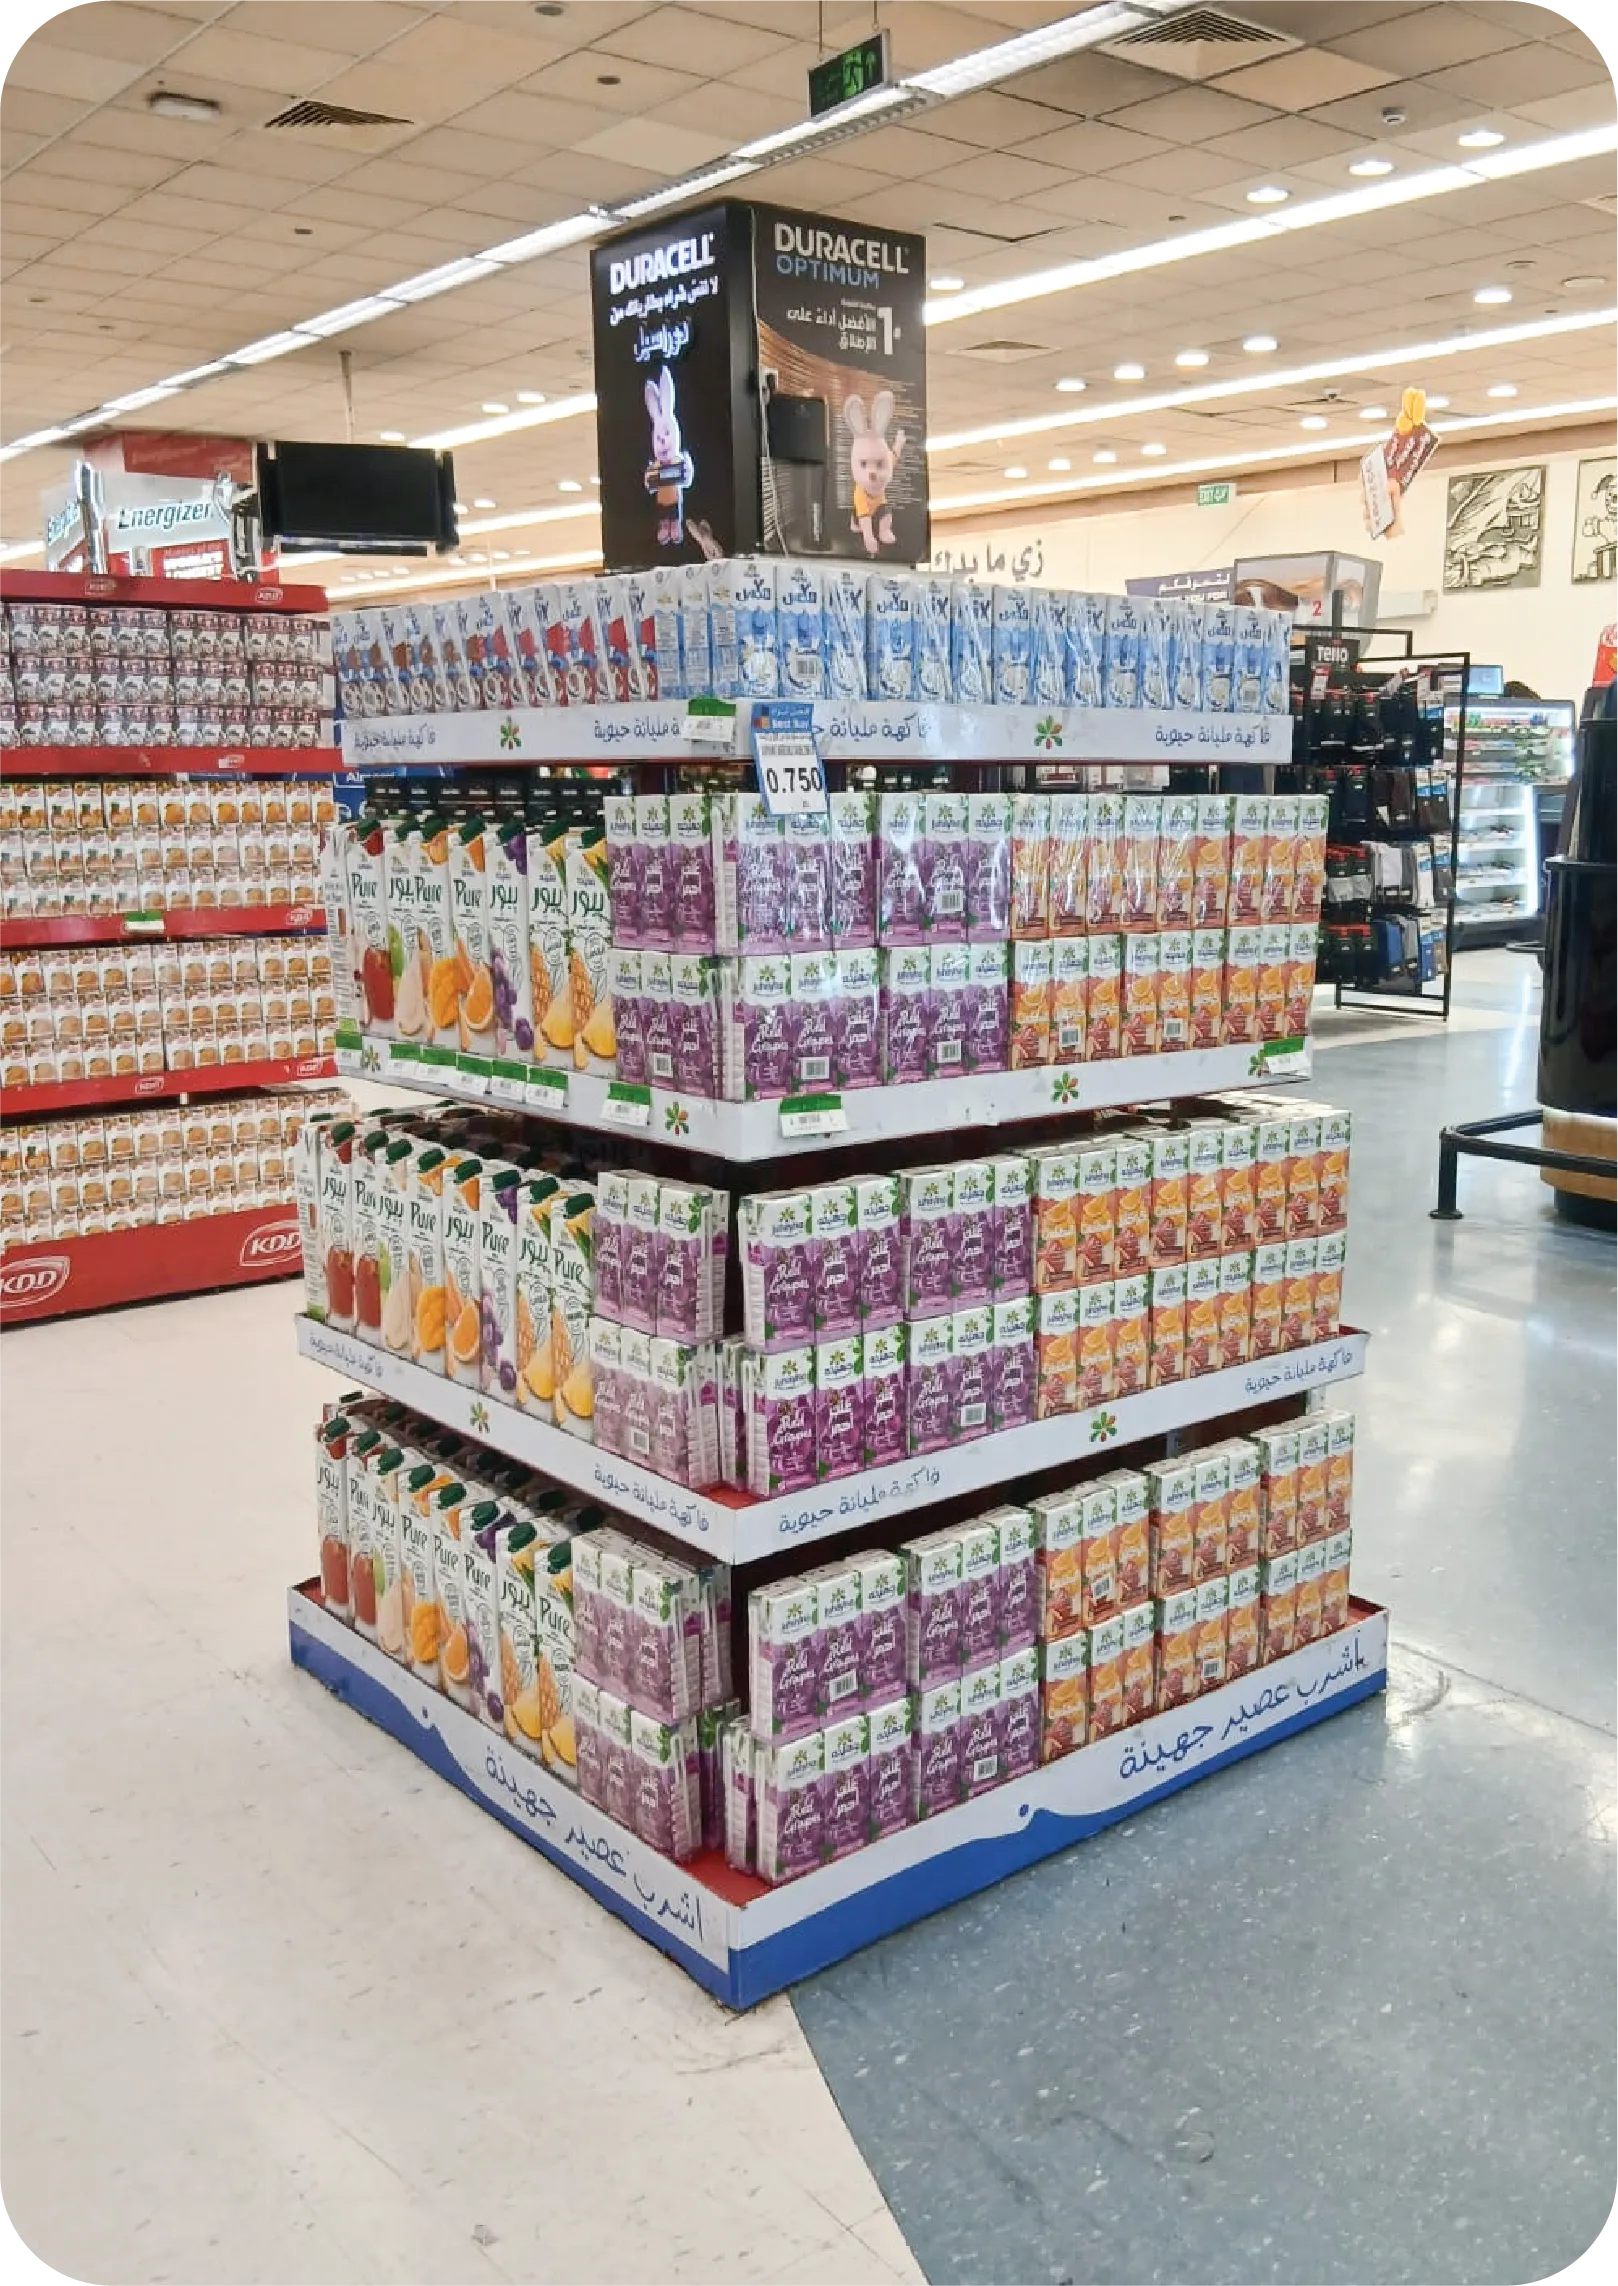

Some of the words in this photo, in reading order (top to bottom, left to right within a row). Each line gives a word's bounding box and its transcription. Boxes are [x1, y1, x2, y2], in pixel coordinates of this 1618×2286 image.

[610, 232, 715, 295] DURACELL
[774, 221, 909, 274] DURACELL
[776, 254, 880, 289] OPTIMUM
[117, 500, 212, 530] Energizer
[986, 541, 1006, 573] ما
[1011, 538, 1044, 583] زي
[1311, 600, 1323, 617] 2
[766, 766, 823, 794] 0.750
[351, 872, 378, 899] Pure
[414, 876, 443, 904] Pure
[453, 878, 482, 908] Pure
[411, 1201, 438, 1234] Pure
[482, 1221, 510, 1255] Pure
[553, 1248, 585, 1286] Pure
[839, 1483, 887, 1515] مليانة
[401, 1514, 428, 1551] Pure
[778, 1507, 834, 1534] حيوية
[433, 1534, 460, 1574] Pure
[463, 1552, 491, 1590] Pure
[539, 1596, 571, 1639] Pure
[1296, 1636, 1364, 1706] اشرب
[1220, 1684, 1291, 1741] عصير
[1118, 1724, 1214, 1779] جهينة
[484, 1744, 557, 1827] جهينة
[563, 1825, 629, 1877] عصير
[633, 1872, 704, 1943] اشرب
